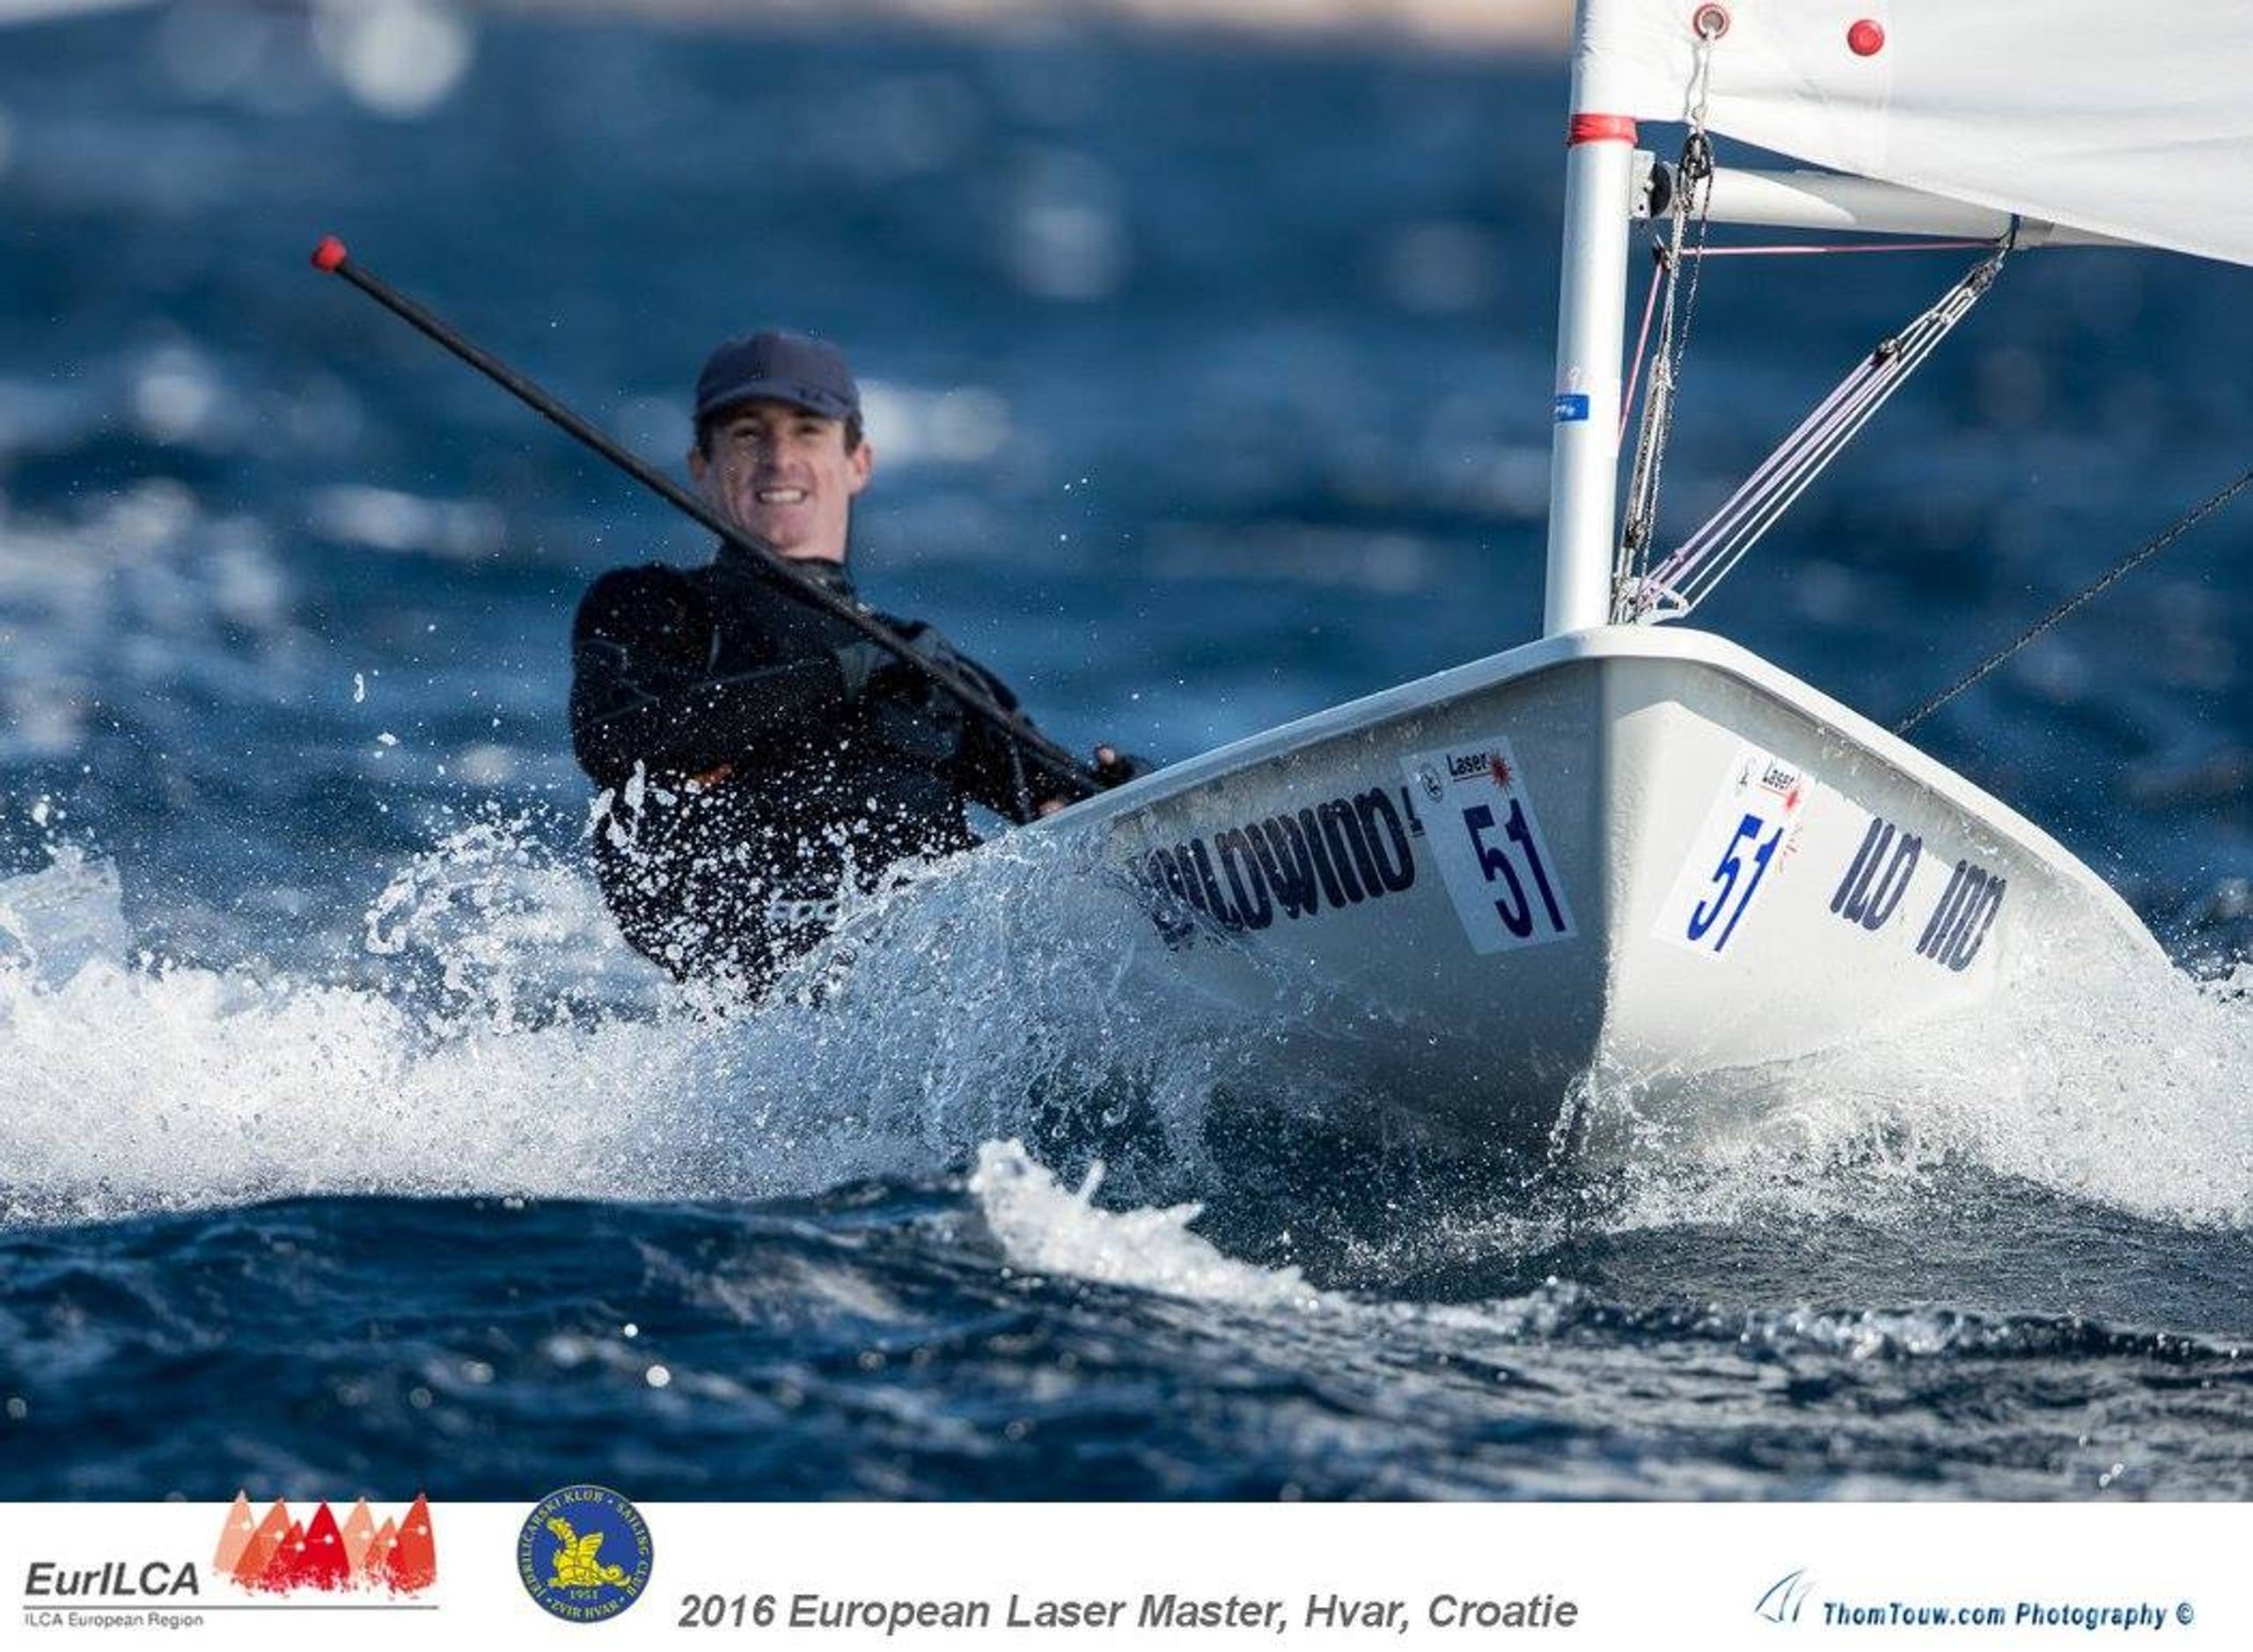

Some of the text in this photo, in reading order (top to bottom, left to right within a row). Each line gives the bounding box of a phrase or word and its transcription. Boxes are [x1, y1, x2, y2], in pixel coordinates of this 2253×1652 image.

[1446, 752, 1487, 776] Laser
[1463, 798, 1566, 939] 51
[1686, 813, 1784, 952] 51
